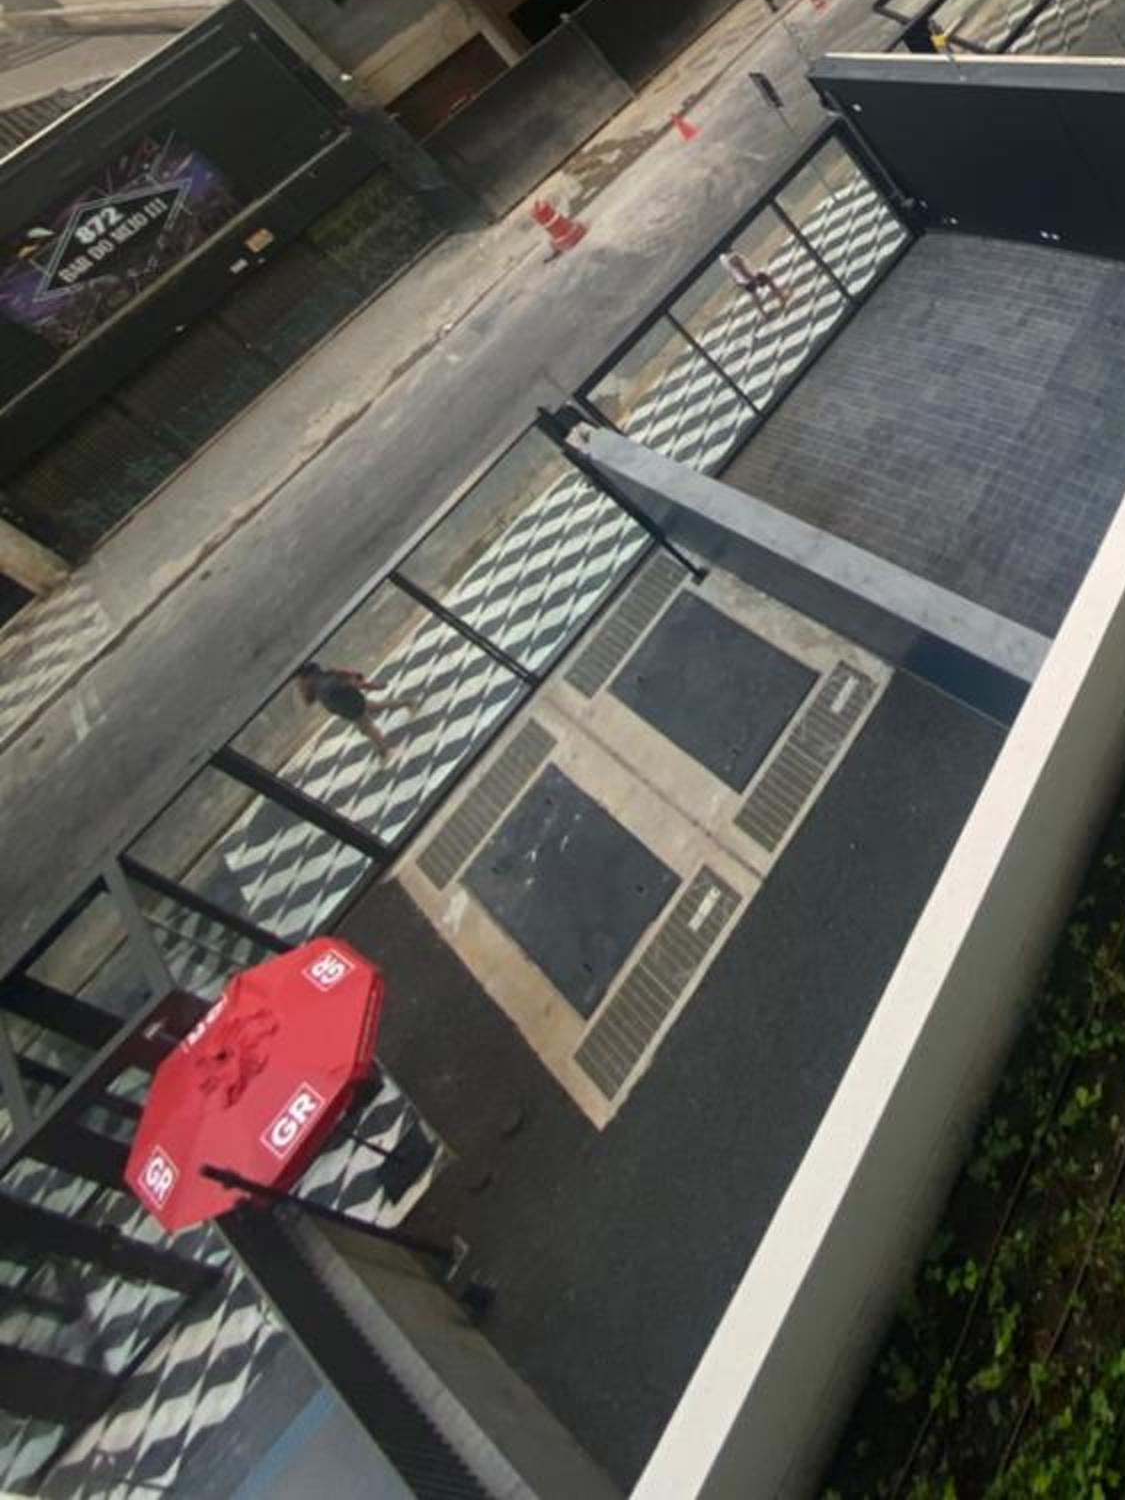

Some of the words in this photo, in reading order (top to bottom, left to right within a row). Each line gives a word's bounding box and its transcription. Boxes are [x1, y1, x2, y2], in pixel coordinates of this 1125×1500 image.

[75, 206, 124, 244] 872
[58, 255, 95, 283] BAR
[87, 238, 115, 261] DO
[311, 954, 345, 984] GR
[271, 1091, 317, 1147] GR
[145, 1156, 173, 1201] GR
